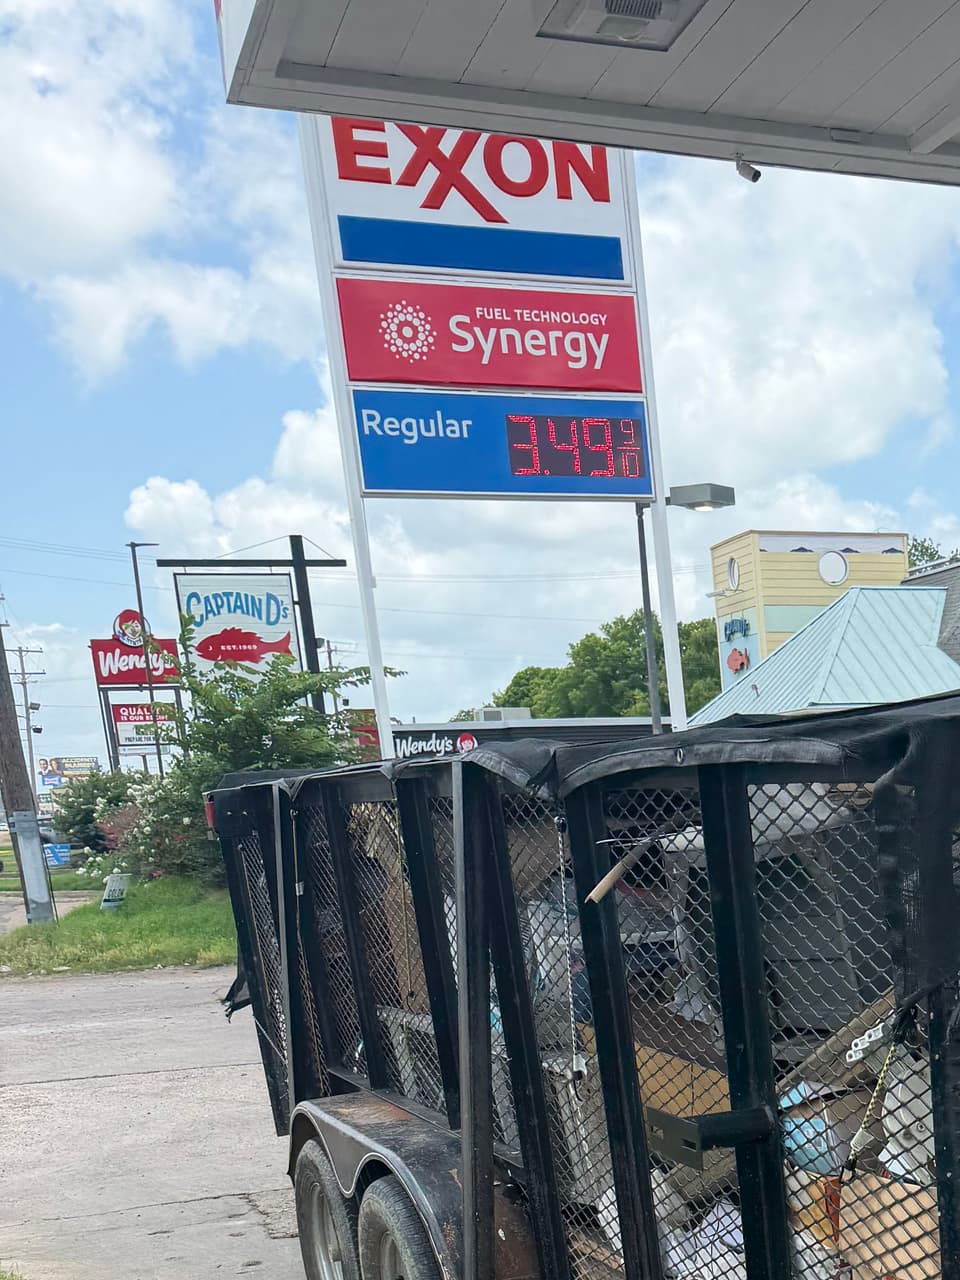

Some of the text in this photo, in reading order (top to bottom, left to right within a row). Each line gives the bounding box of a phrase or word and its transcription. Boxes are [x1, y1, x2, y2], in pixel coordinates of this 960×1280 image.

[331, 116, 610, 224] EXXON
[475, 307, 608, 326] FUEL TECHNOLOGY
[448, 315, 609, 370] Synergy
[361, 409, 473, 445] Regular
[186, 591, 289, 627] CAPTAIN D's
[396, 732, 453, 758] Wendy's
